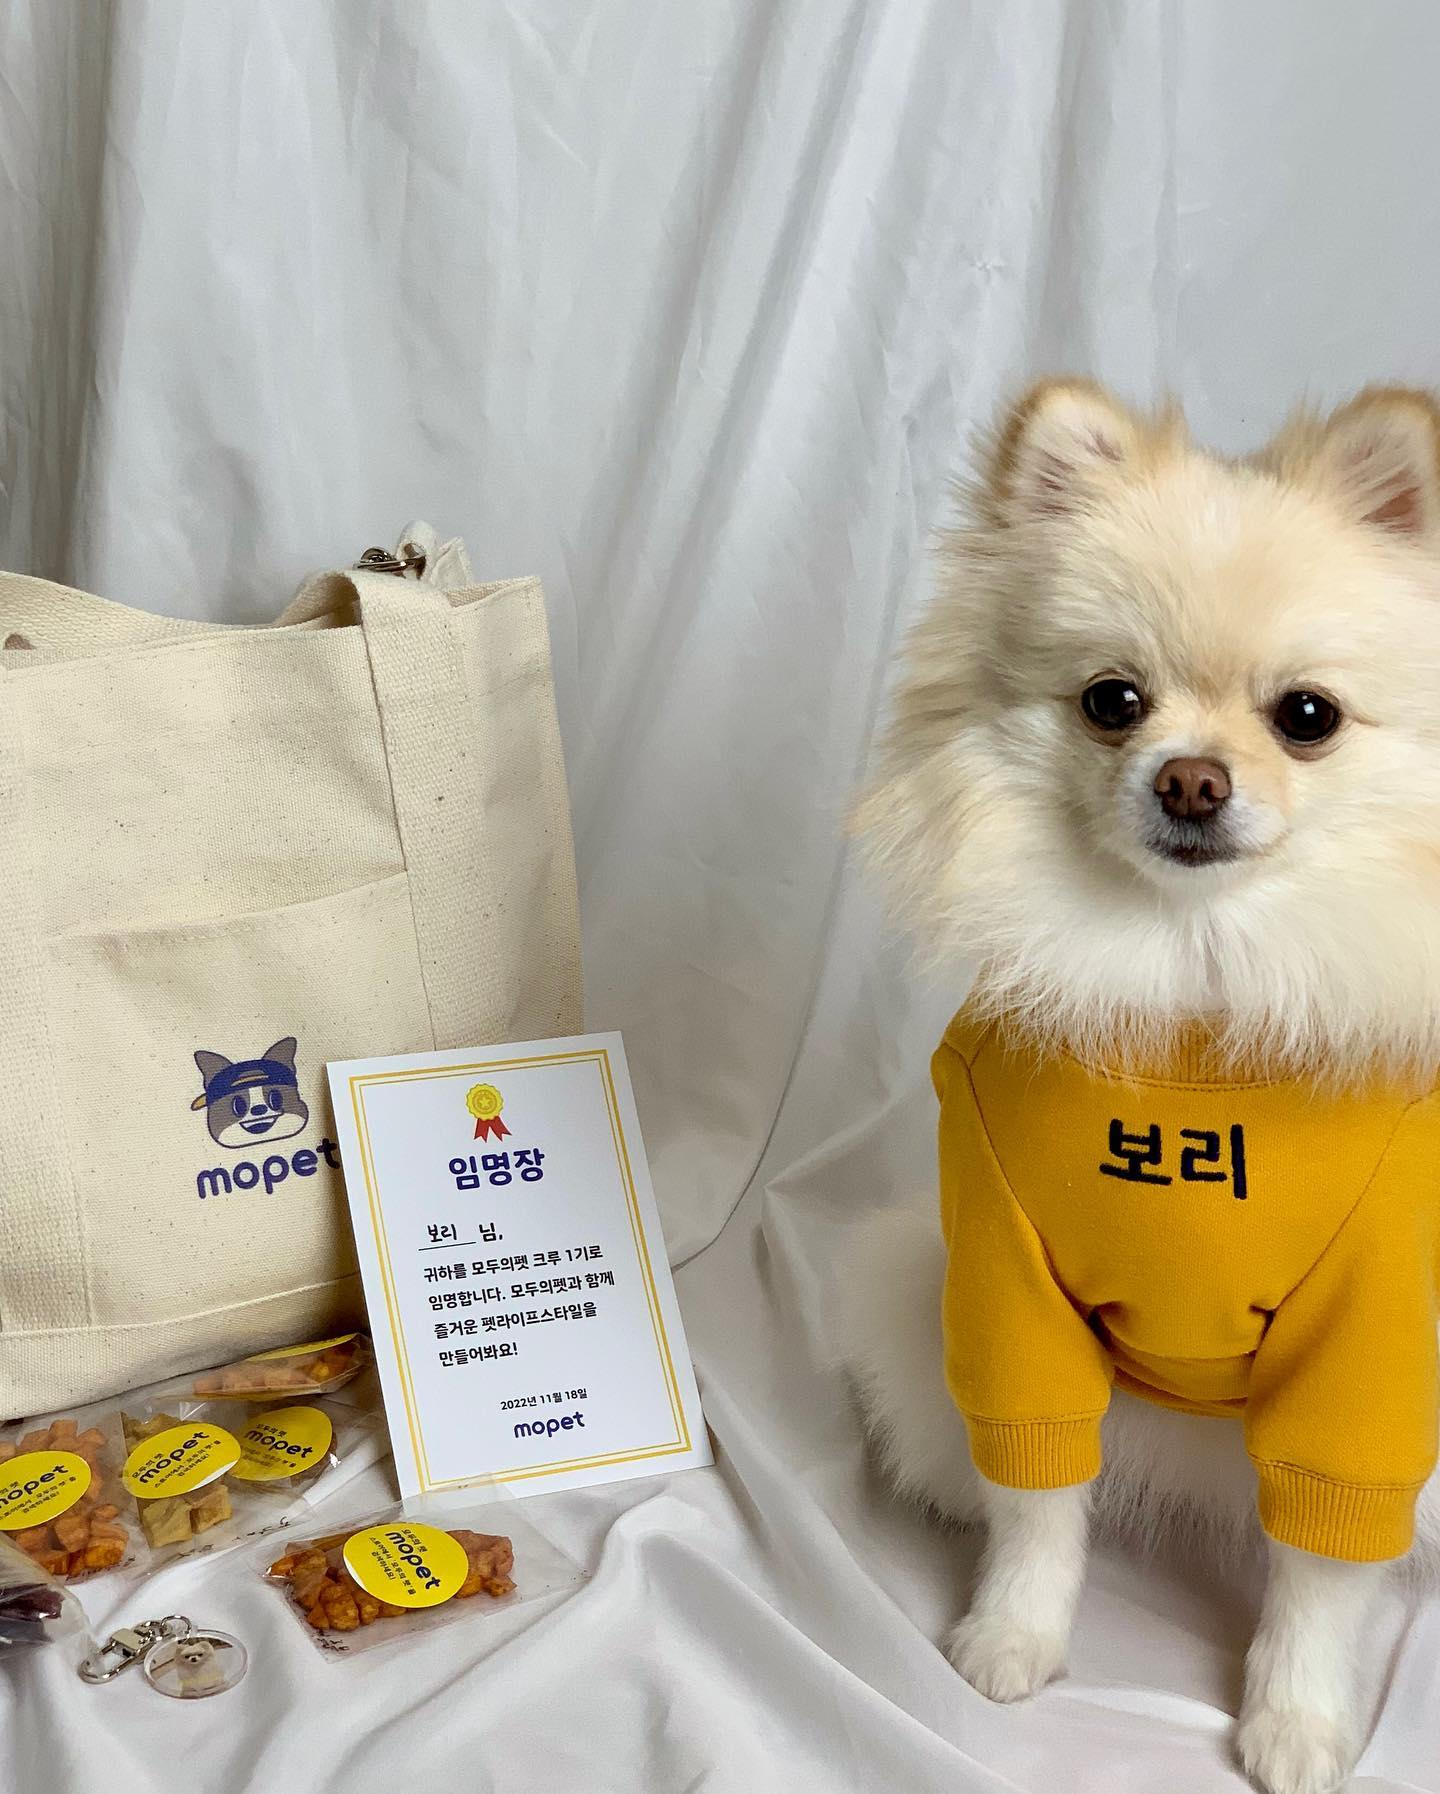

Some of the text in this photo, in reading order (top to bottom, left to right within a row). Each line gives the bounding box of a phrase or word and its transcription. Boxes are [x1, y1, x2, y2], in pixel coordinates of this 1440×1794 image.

[197, 1138, 340, 1199] mopet
[449, 1148, 545, 1190] 임명장
[1099, 1118, 1248, 1200] 보리
[427, 1222, 503, 1243] 보리 님,
[423, 1245, 604, 1283] 귀하를 모두의펫 크루 1기로
[428, 1271, 615, 1311] 임명합니다. 모두의펫과 함께
[434, 1302, 598, 1340] 즐거운 펫라이프스타일을
[438, 1342, 519, 1368] 만들어봐요!
[500, 1388, 588, 1410] 2022년 11월 18일
[514, 1411, 585, 1438] mopet
[139, 1431, 210, 1483] mopet
[244, 1430, 313, 1458] mopet
[401, 1529, 421, 1545] 모두의
[385, 1532, 441, 1590] mopet
